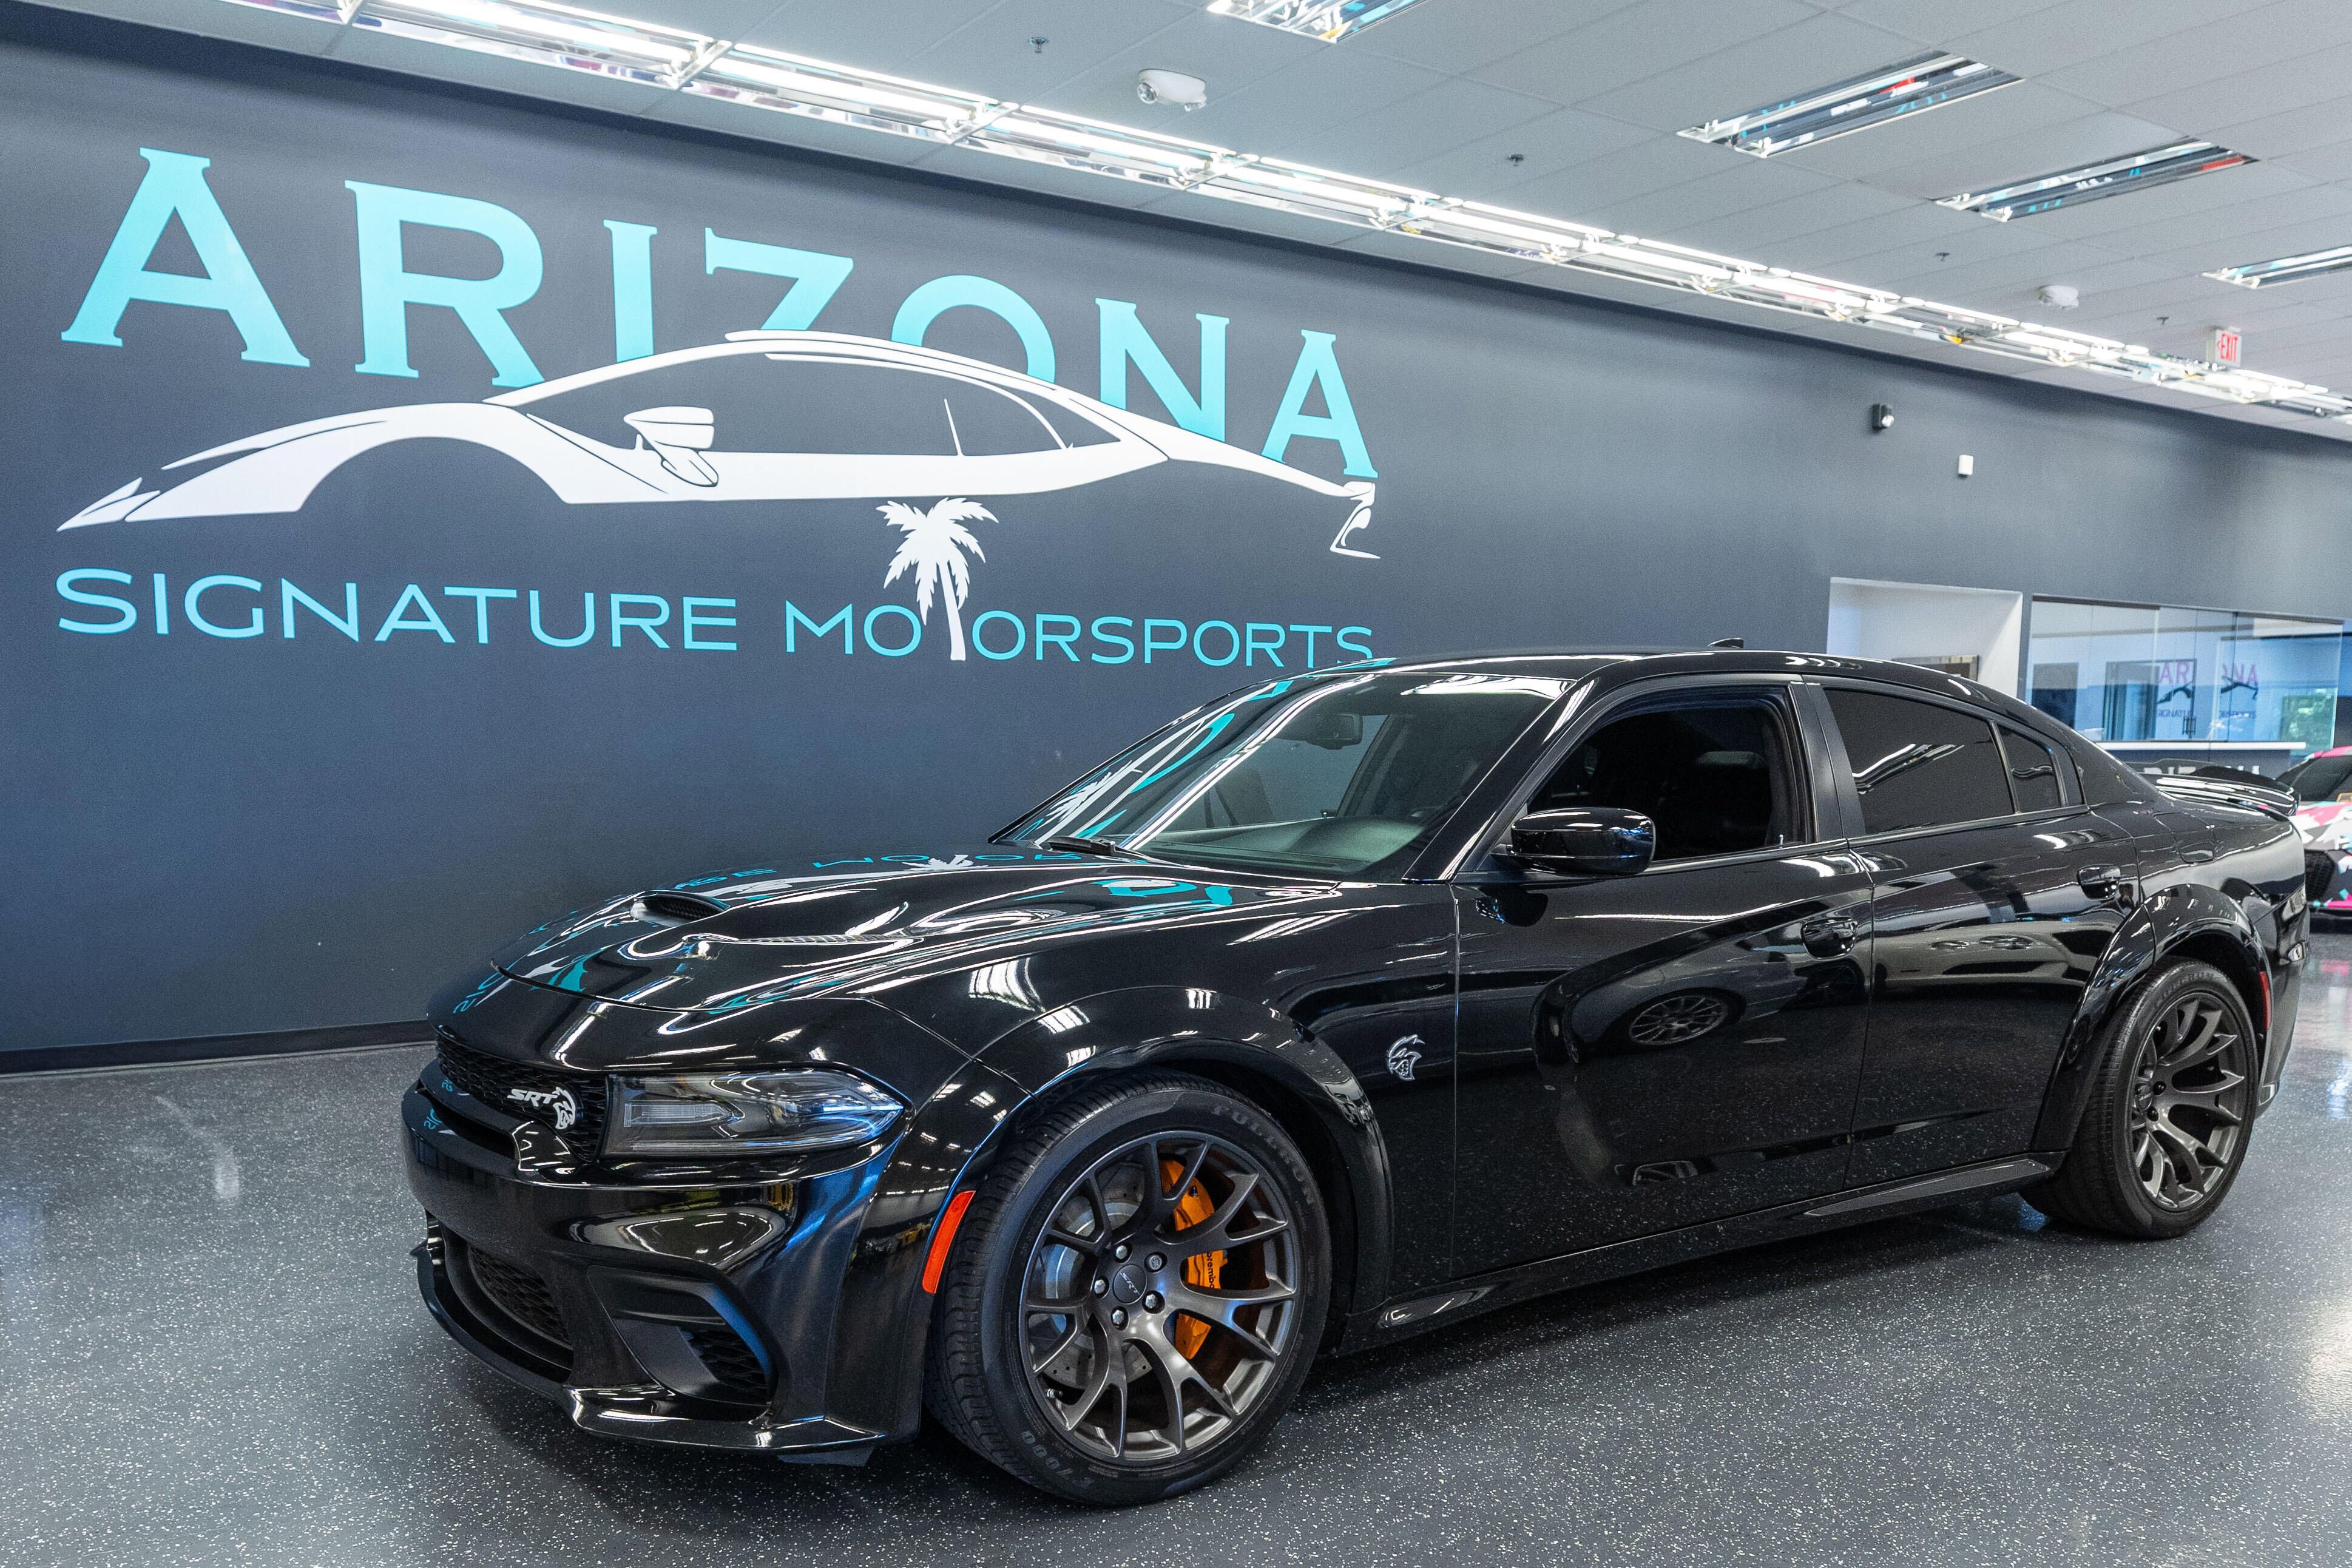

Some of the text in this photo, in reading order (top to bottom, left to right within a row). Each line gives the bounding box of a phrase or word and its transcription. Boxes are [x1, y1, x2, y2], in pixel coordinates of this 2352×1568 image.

[60, 147, 1379, 479] ARIZONA
[2220, 332, 2238, 362] EXIT
[55, 567, 738, 652] SIGNATURE
[507, 1089, 558, 1107] SRT
[1120, 1272, 1140, 1295] SRT
